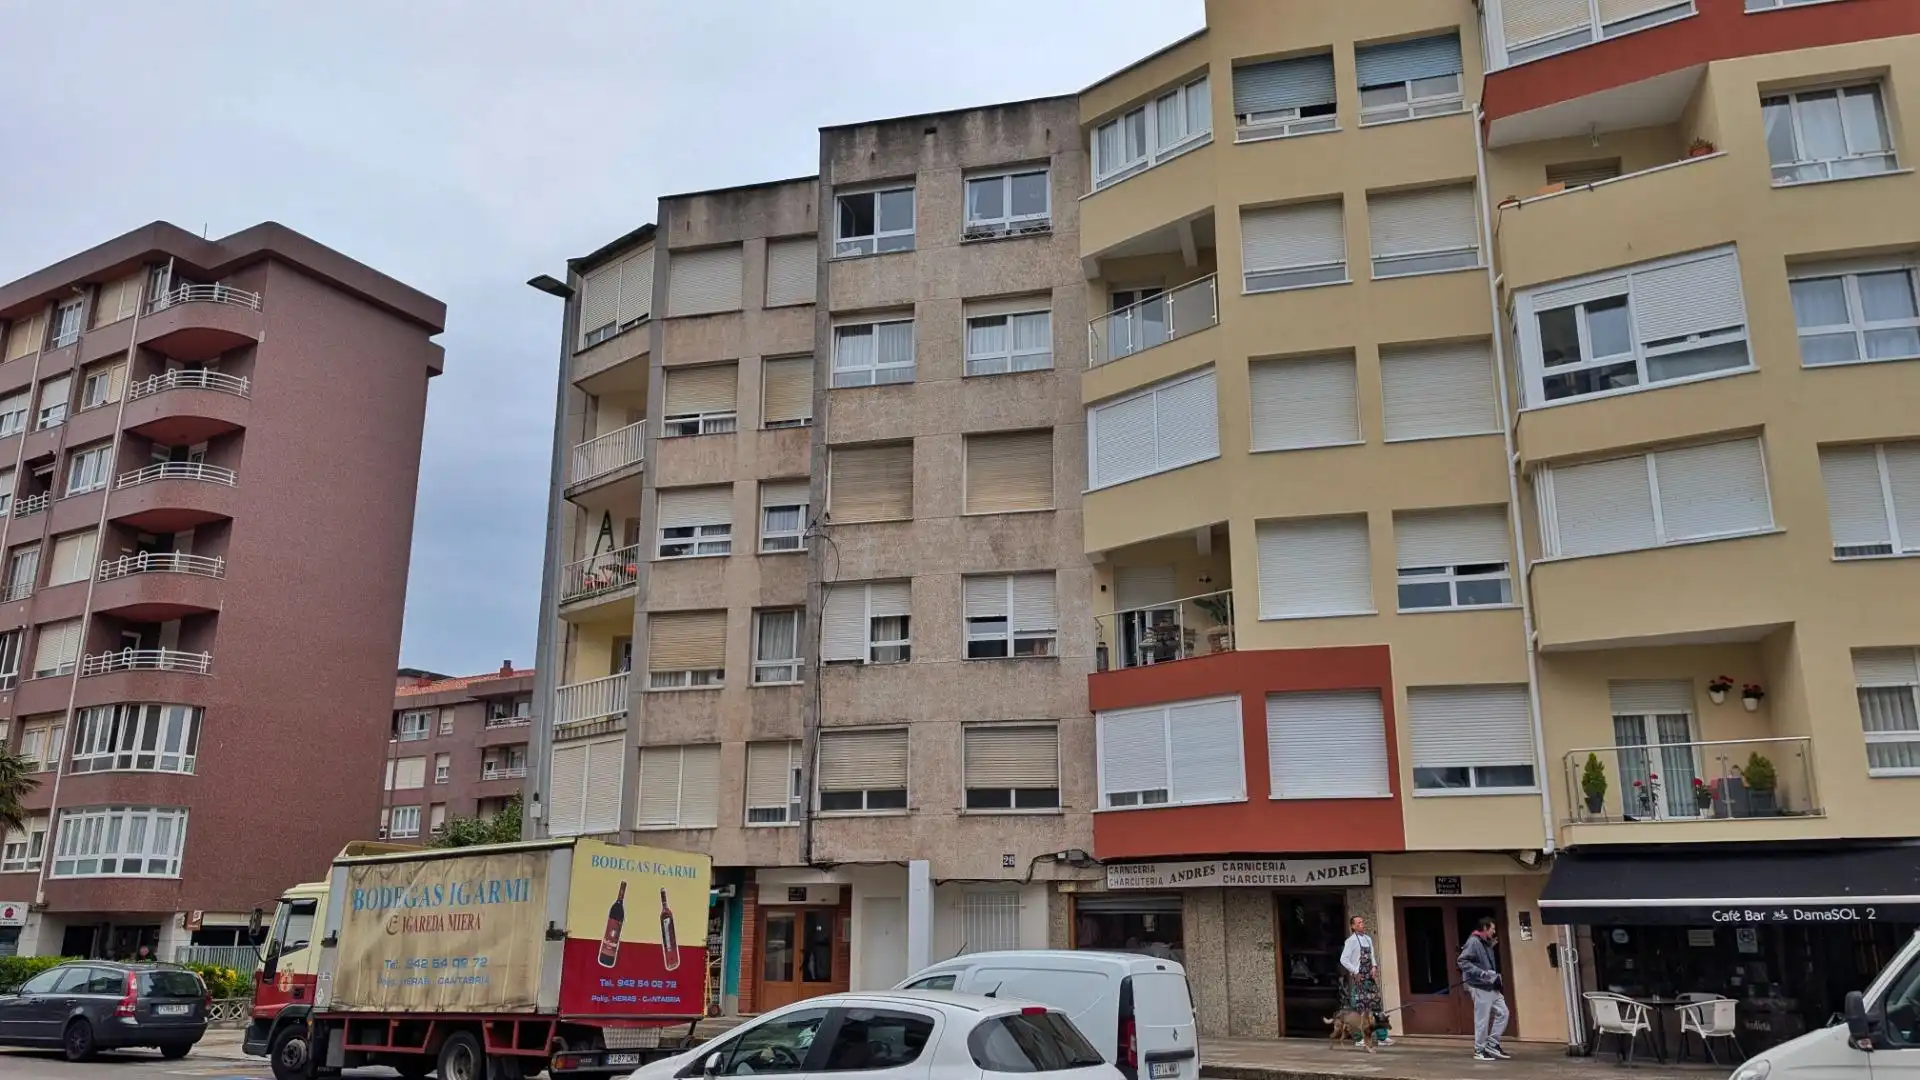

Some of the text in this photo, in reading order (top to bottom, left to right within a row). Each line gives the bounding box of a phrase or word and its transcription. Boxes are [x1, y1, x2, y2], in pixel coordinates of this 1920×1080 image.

[1003, 855, 1015, 866] 26
[1222, 862, 1286, 871] CARNICERIA
[591, 855, 697, 879] BODEGAS IGARMI
[1108, 865, 1156, 875] CARNICERIA
[1305, 862, 1367, 882] ANDRES
[1168, 864, 1216, 884] ANDRES
[1222, 874, 1297, 884] CHARCUTERIA
[1109, 877, 1164, 887] CHARCUTERIA
[353, 878, 531, 911] BODEGAS IGARMI
[1712, 908, 1877, 922] Café Bar DamaSOL 2
[402, 914, 444, 934] IGAREDA
[448, 913, 481, 931] MIERA
[600, 978, 677, 989] Tel. 942 54 02 72
